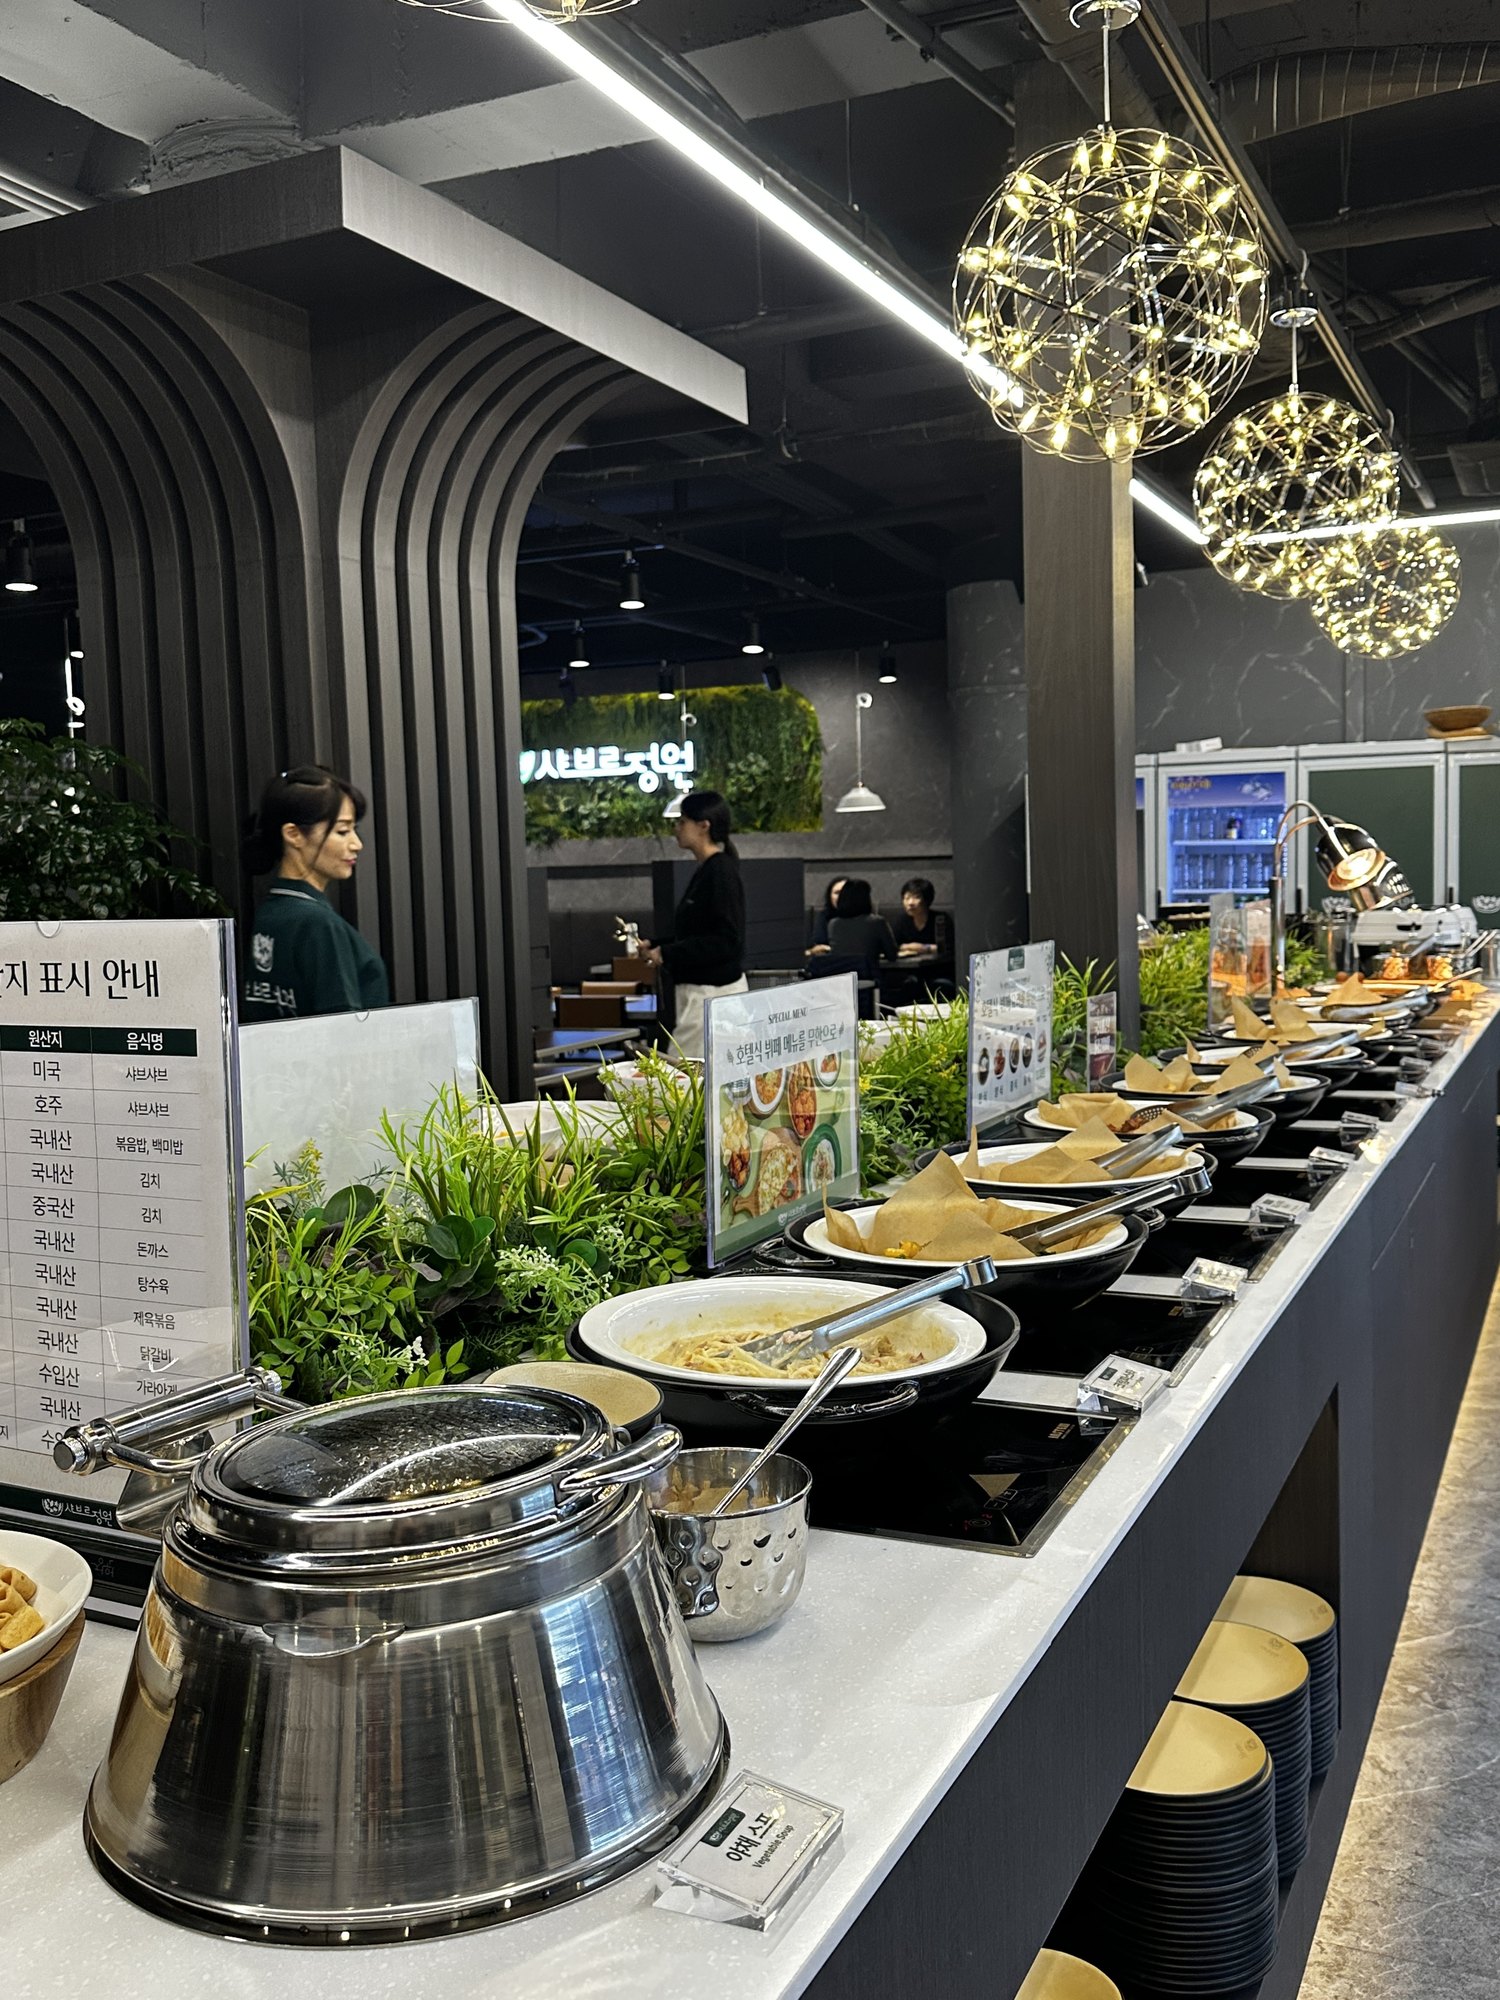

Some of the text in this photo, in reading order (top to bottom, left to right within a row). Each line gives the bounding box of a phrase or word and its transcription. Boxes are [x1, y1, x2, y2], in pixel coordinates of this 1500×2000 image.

[534, 740, 694, 794] 샤브르정원
[0, 959, 160, 1000] 지 표시 안내
[768, 1010, 790, 1025] SPECIAL
[28, 1029, 63, 1048] 원산지
[126, 1032, 164, 1051] 음식명
[736, 1023, 837, 1065] 호텔식 뷔페 메뉴를 무한으로
[33, 1060, 61, 1081] 미국
[125, 1066, 169, 1082] 샤브샤브
[34, 1095, 63, 1116] 호주
[127, 1101, 170, 1117] 샤브샤브
[29, 1129, 72, 1151] 국내산
[115, 1136, 184, 1155] 볶음밥, 백미밥
[31, 1163, 74, 1185] 국내산
[140, 1173, 161, 1189] 김치
[32, 1196, 75, 1219] 중국산
[141, 1208, 162, 1224] 김치
[33, 1230, 76, 1253] 국내산
[136, 1242, 169, 1259] 돈까스
[34, 1263, 77, 1287] 국내산
[137, 1276, 170, 1295] 탕수육
[35, 1296, 77, 1320] 국내산
[133, 1311, 176, 1330] 제육볶음
[37, 1330, 79, 1354] 국내산
[140, 1346, 172, 1363] 닭갈비
[39, 1363, 80, 1388] 수입산
[39, 1396, 82, 1421] 국내산
[65, 1502, 113, 1527] 샤브르정원
[726, 1812, 780, 1861] 야채 스프
[752, 1824, 795, 1868] Vegetable Soup
